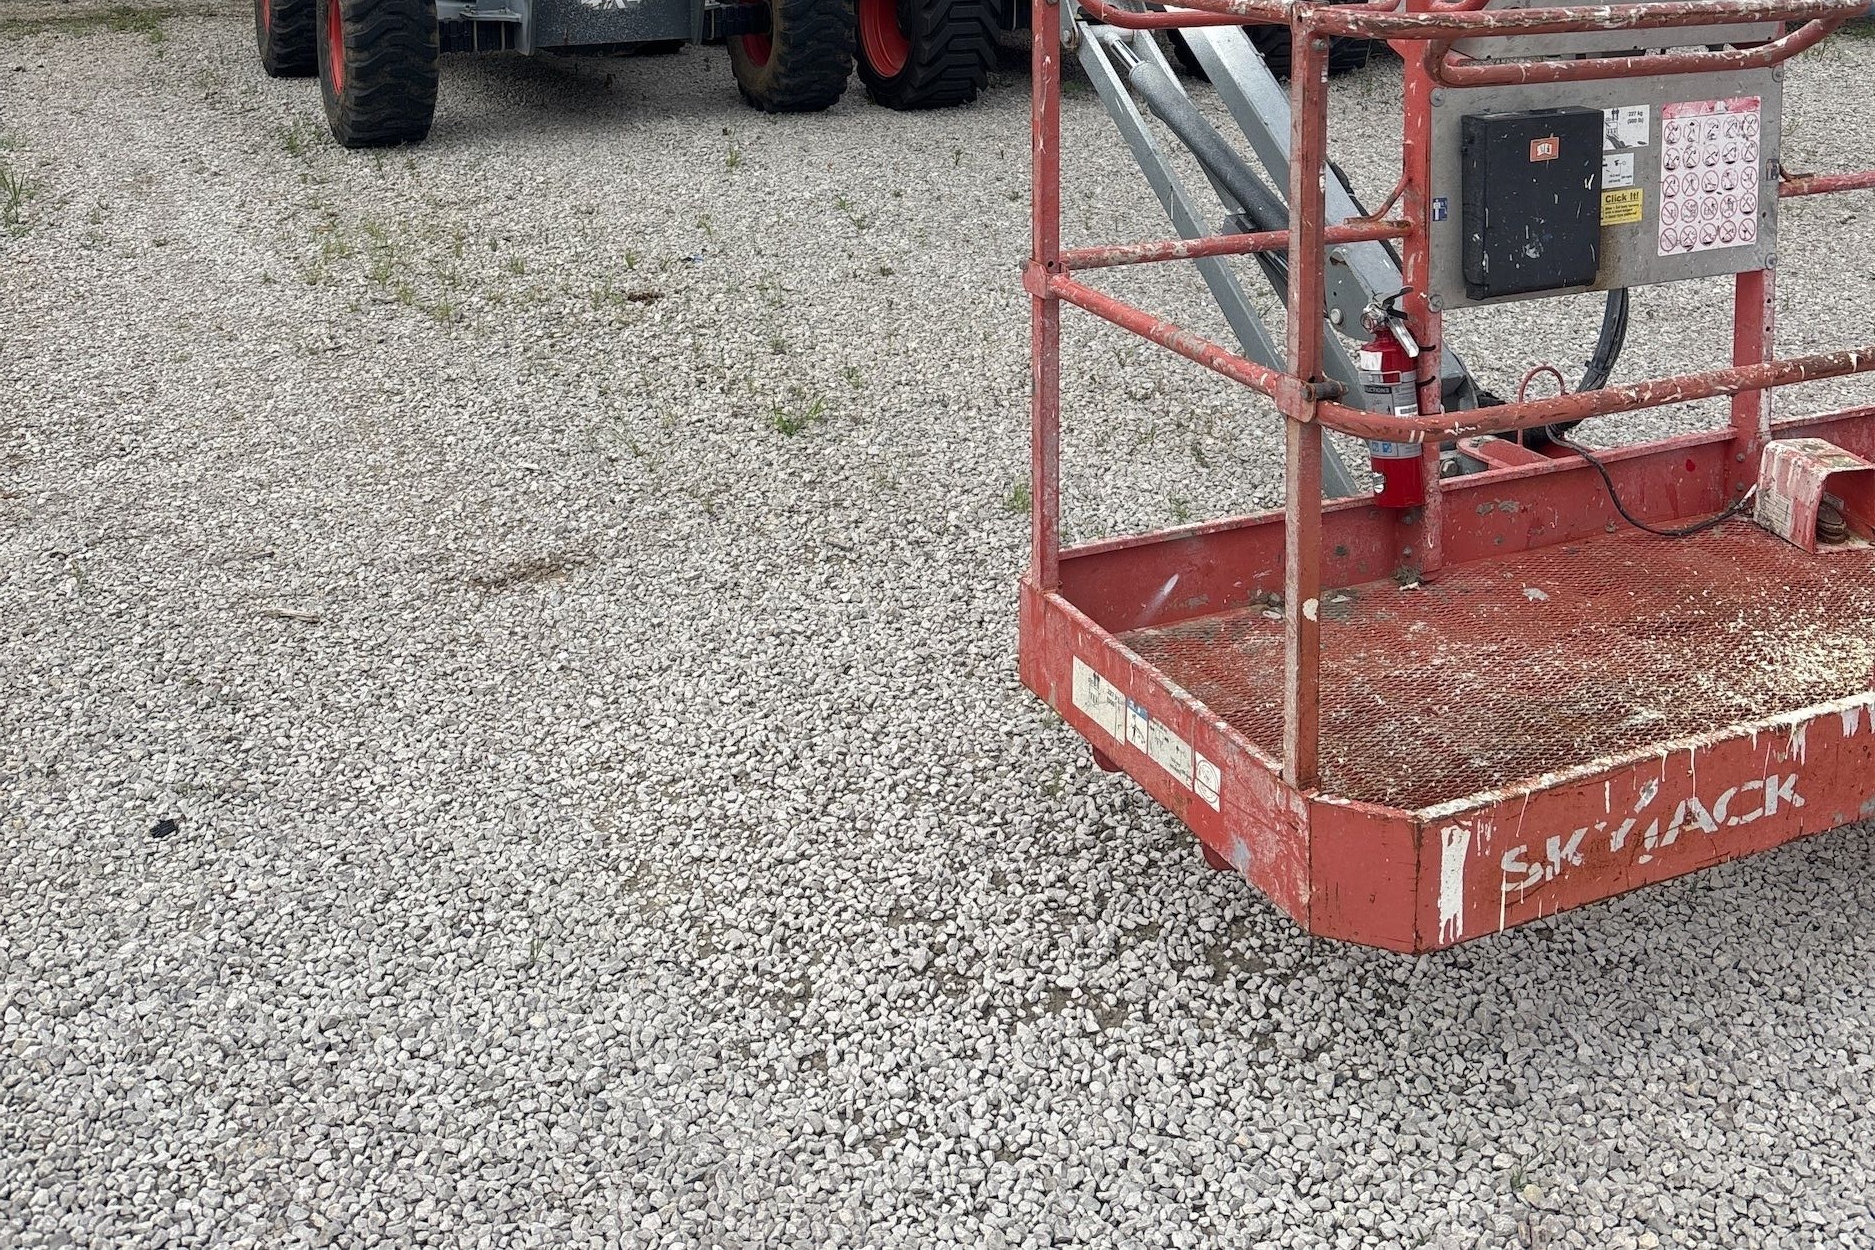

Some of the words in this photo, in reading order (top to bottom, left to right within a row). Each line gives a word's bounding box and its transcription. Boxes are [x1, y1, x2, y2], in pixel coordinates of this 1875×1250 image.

[1605, 192, 1627, 203] Click
[1630, 191, 1640, 201] It!
[1500, 773, 1806, 892] SKYJACK
